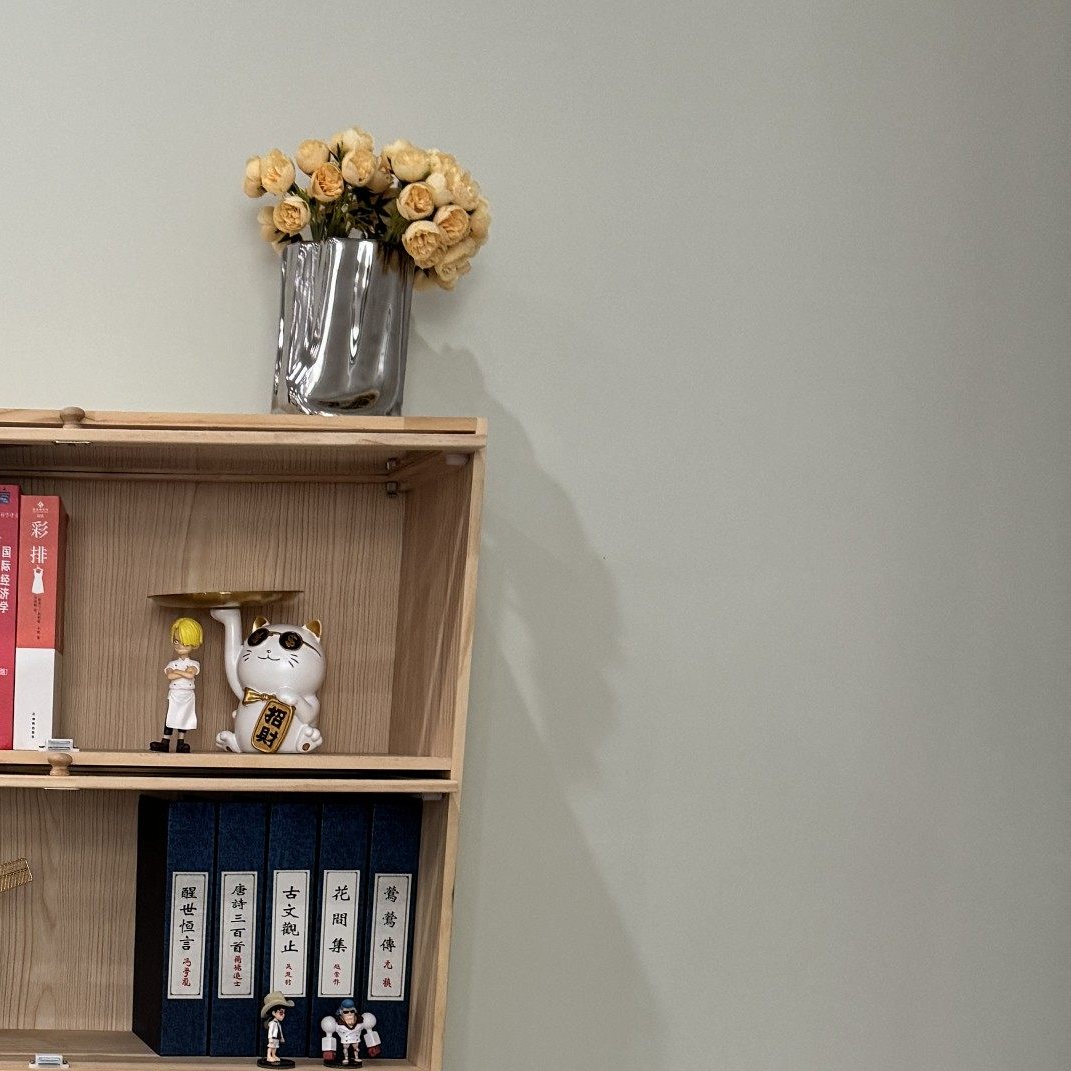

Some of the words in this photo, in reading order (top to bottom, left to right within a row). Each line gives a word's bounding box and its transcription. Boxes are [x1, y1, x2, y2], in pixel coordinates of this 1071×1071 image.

[30, 520, 48, 564] 彩排
[256, 705, 288, 749] 招財
[179, 886, 197, 951] 醒世恒言
[229, 883, 247, 953] 唐詩三百首
[281, 885, 300, 953] 古文觀止
[329, 884, 350, 953] 花間集
